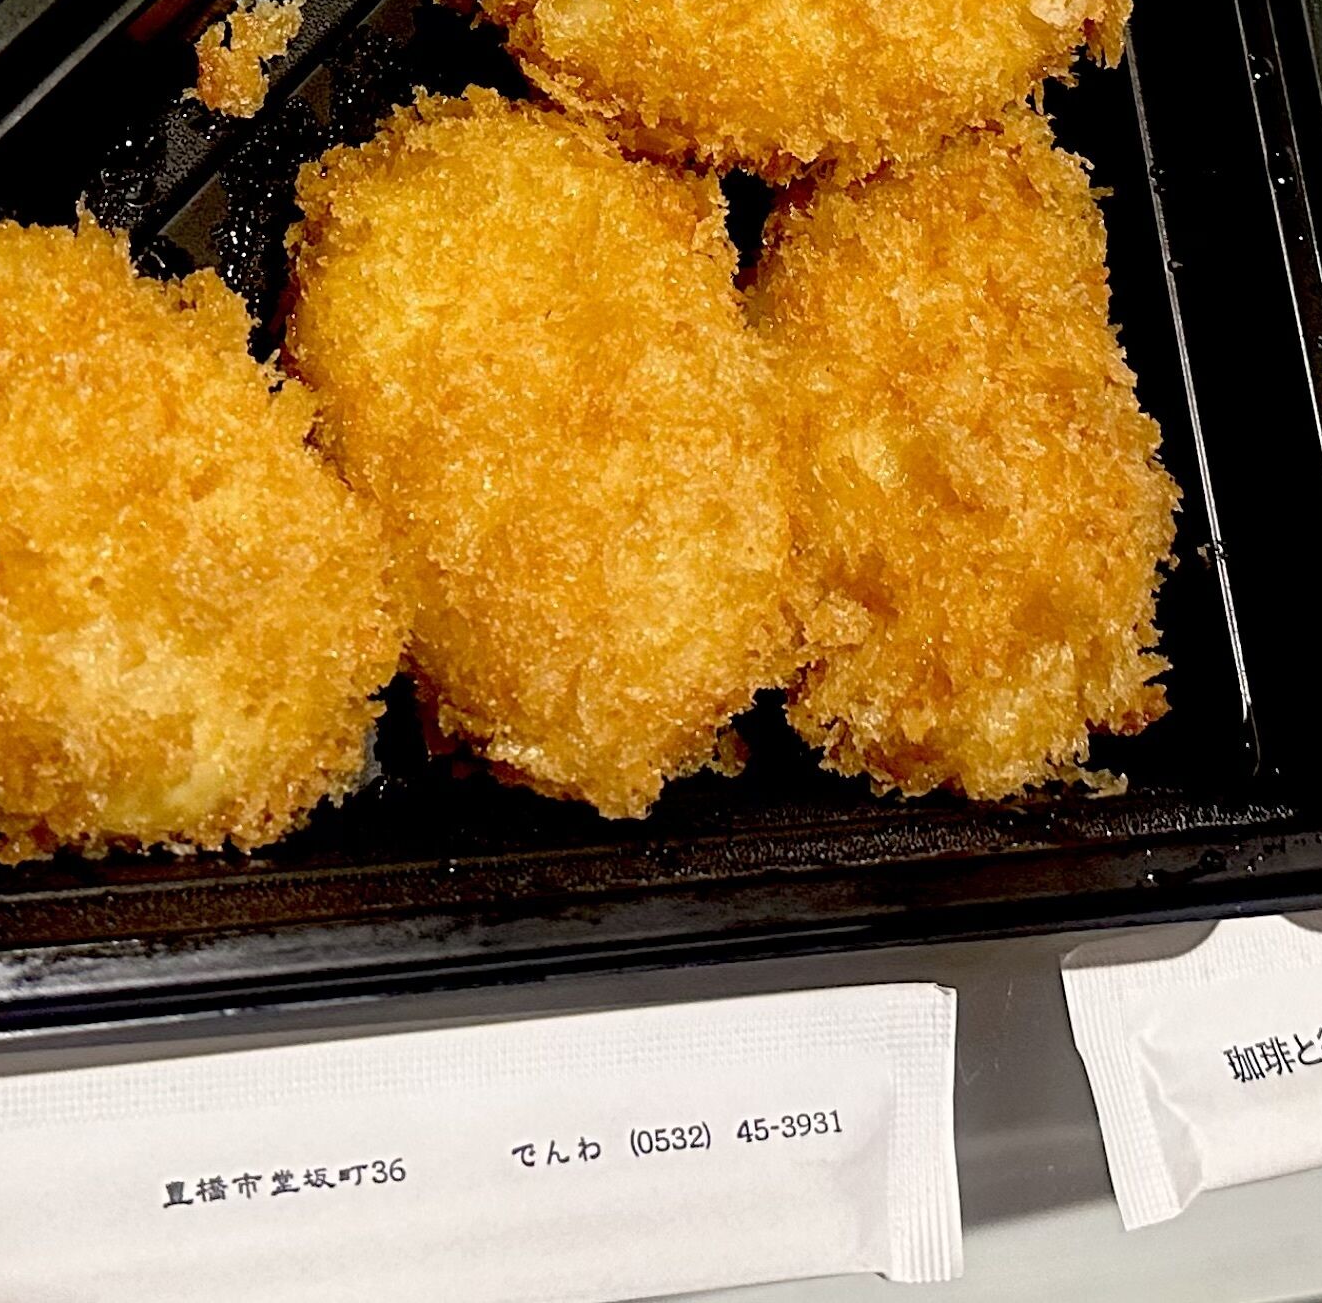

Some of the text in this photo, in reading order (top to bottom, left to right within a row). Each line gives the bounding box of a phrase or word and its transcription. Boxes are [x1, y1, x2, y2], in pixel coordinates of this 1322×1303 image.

[512, 1136, 602, 1167] でんわ
[629, 1121, 712, 1157] (0532)
[735, 1109, 843, 1143] 45-3931
